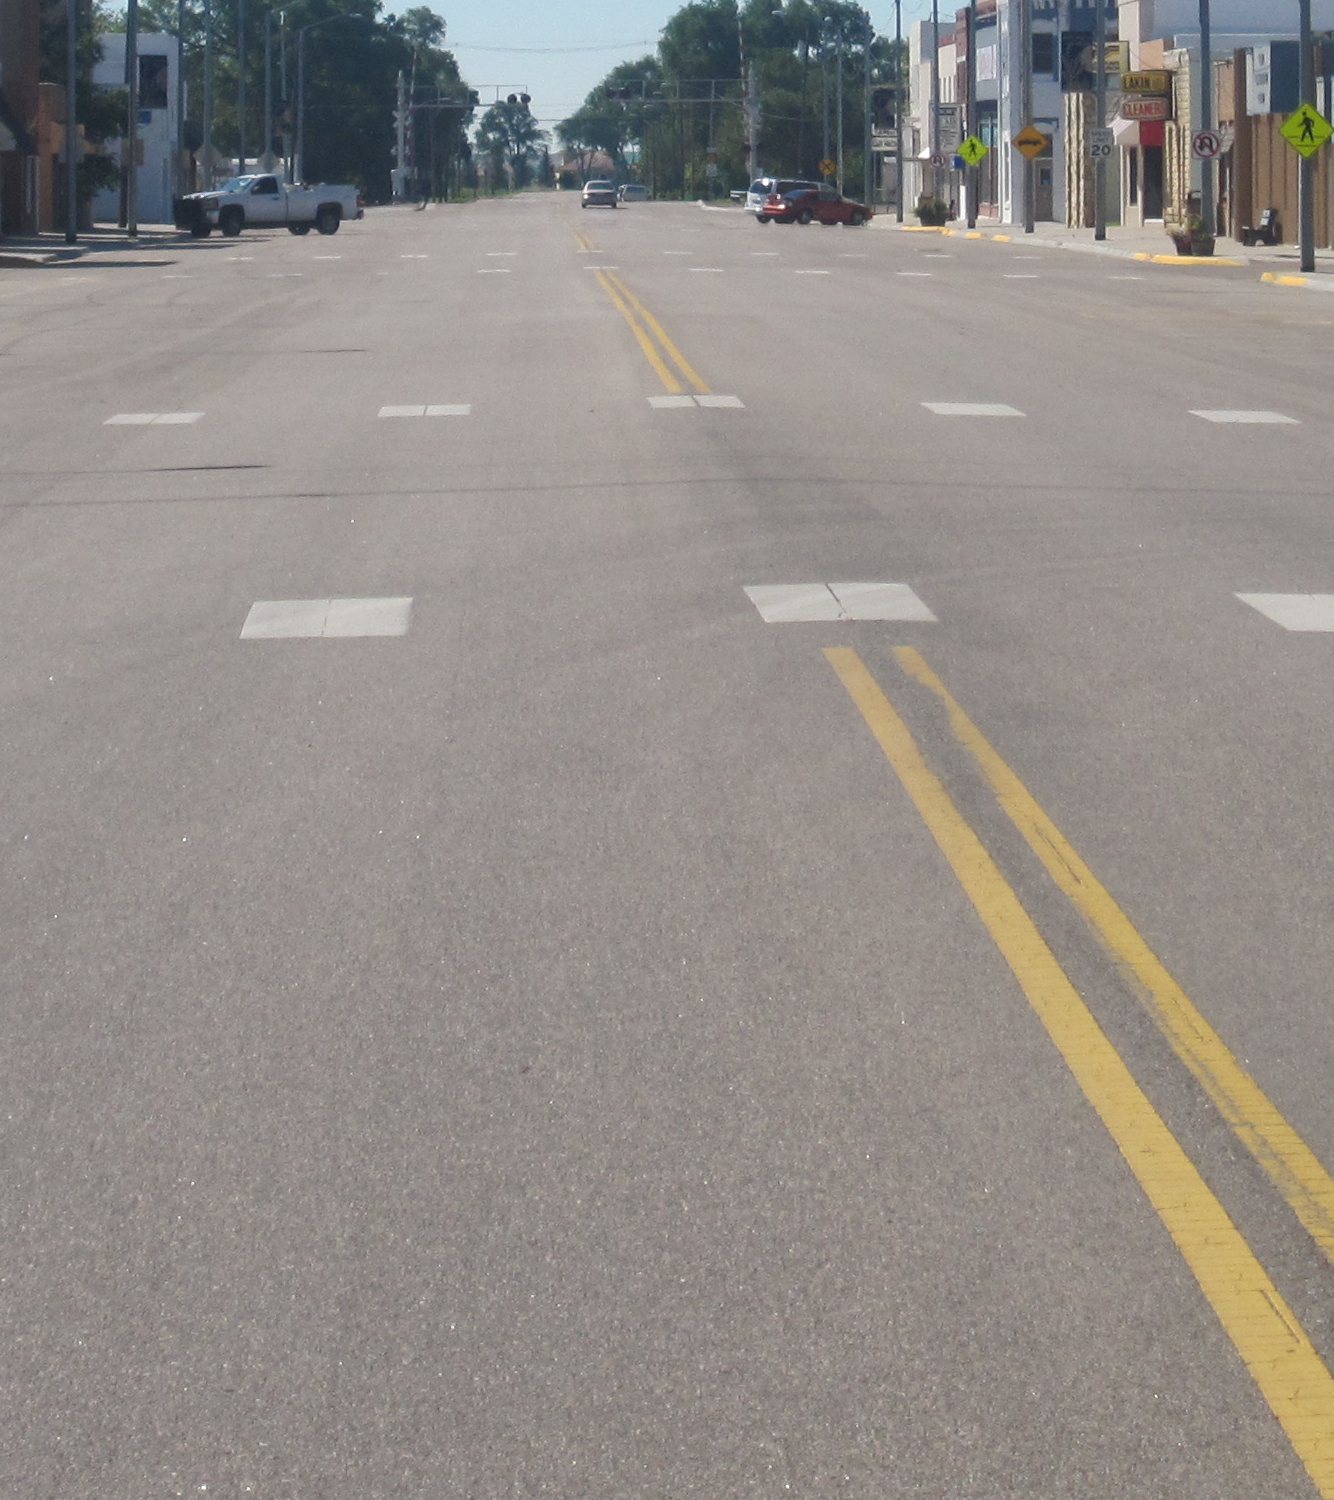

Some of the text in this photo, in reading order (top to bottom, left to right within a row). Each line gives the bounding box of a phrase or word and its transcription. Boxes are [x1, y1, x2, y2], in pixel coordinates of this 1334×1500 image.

[1122, 76, 1152, 90] LAKIN
[1124, 102, 1166, 117] CLEANERS
[1091, 144, 1111, 156] 20
